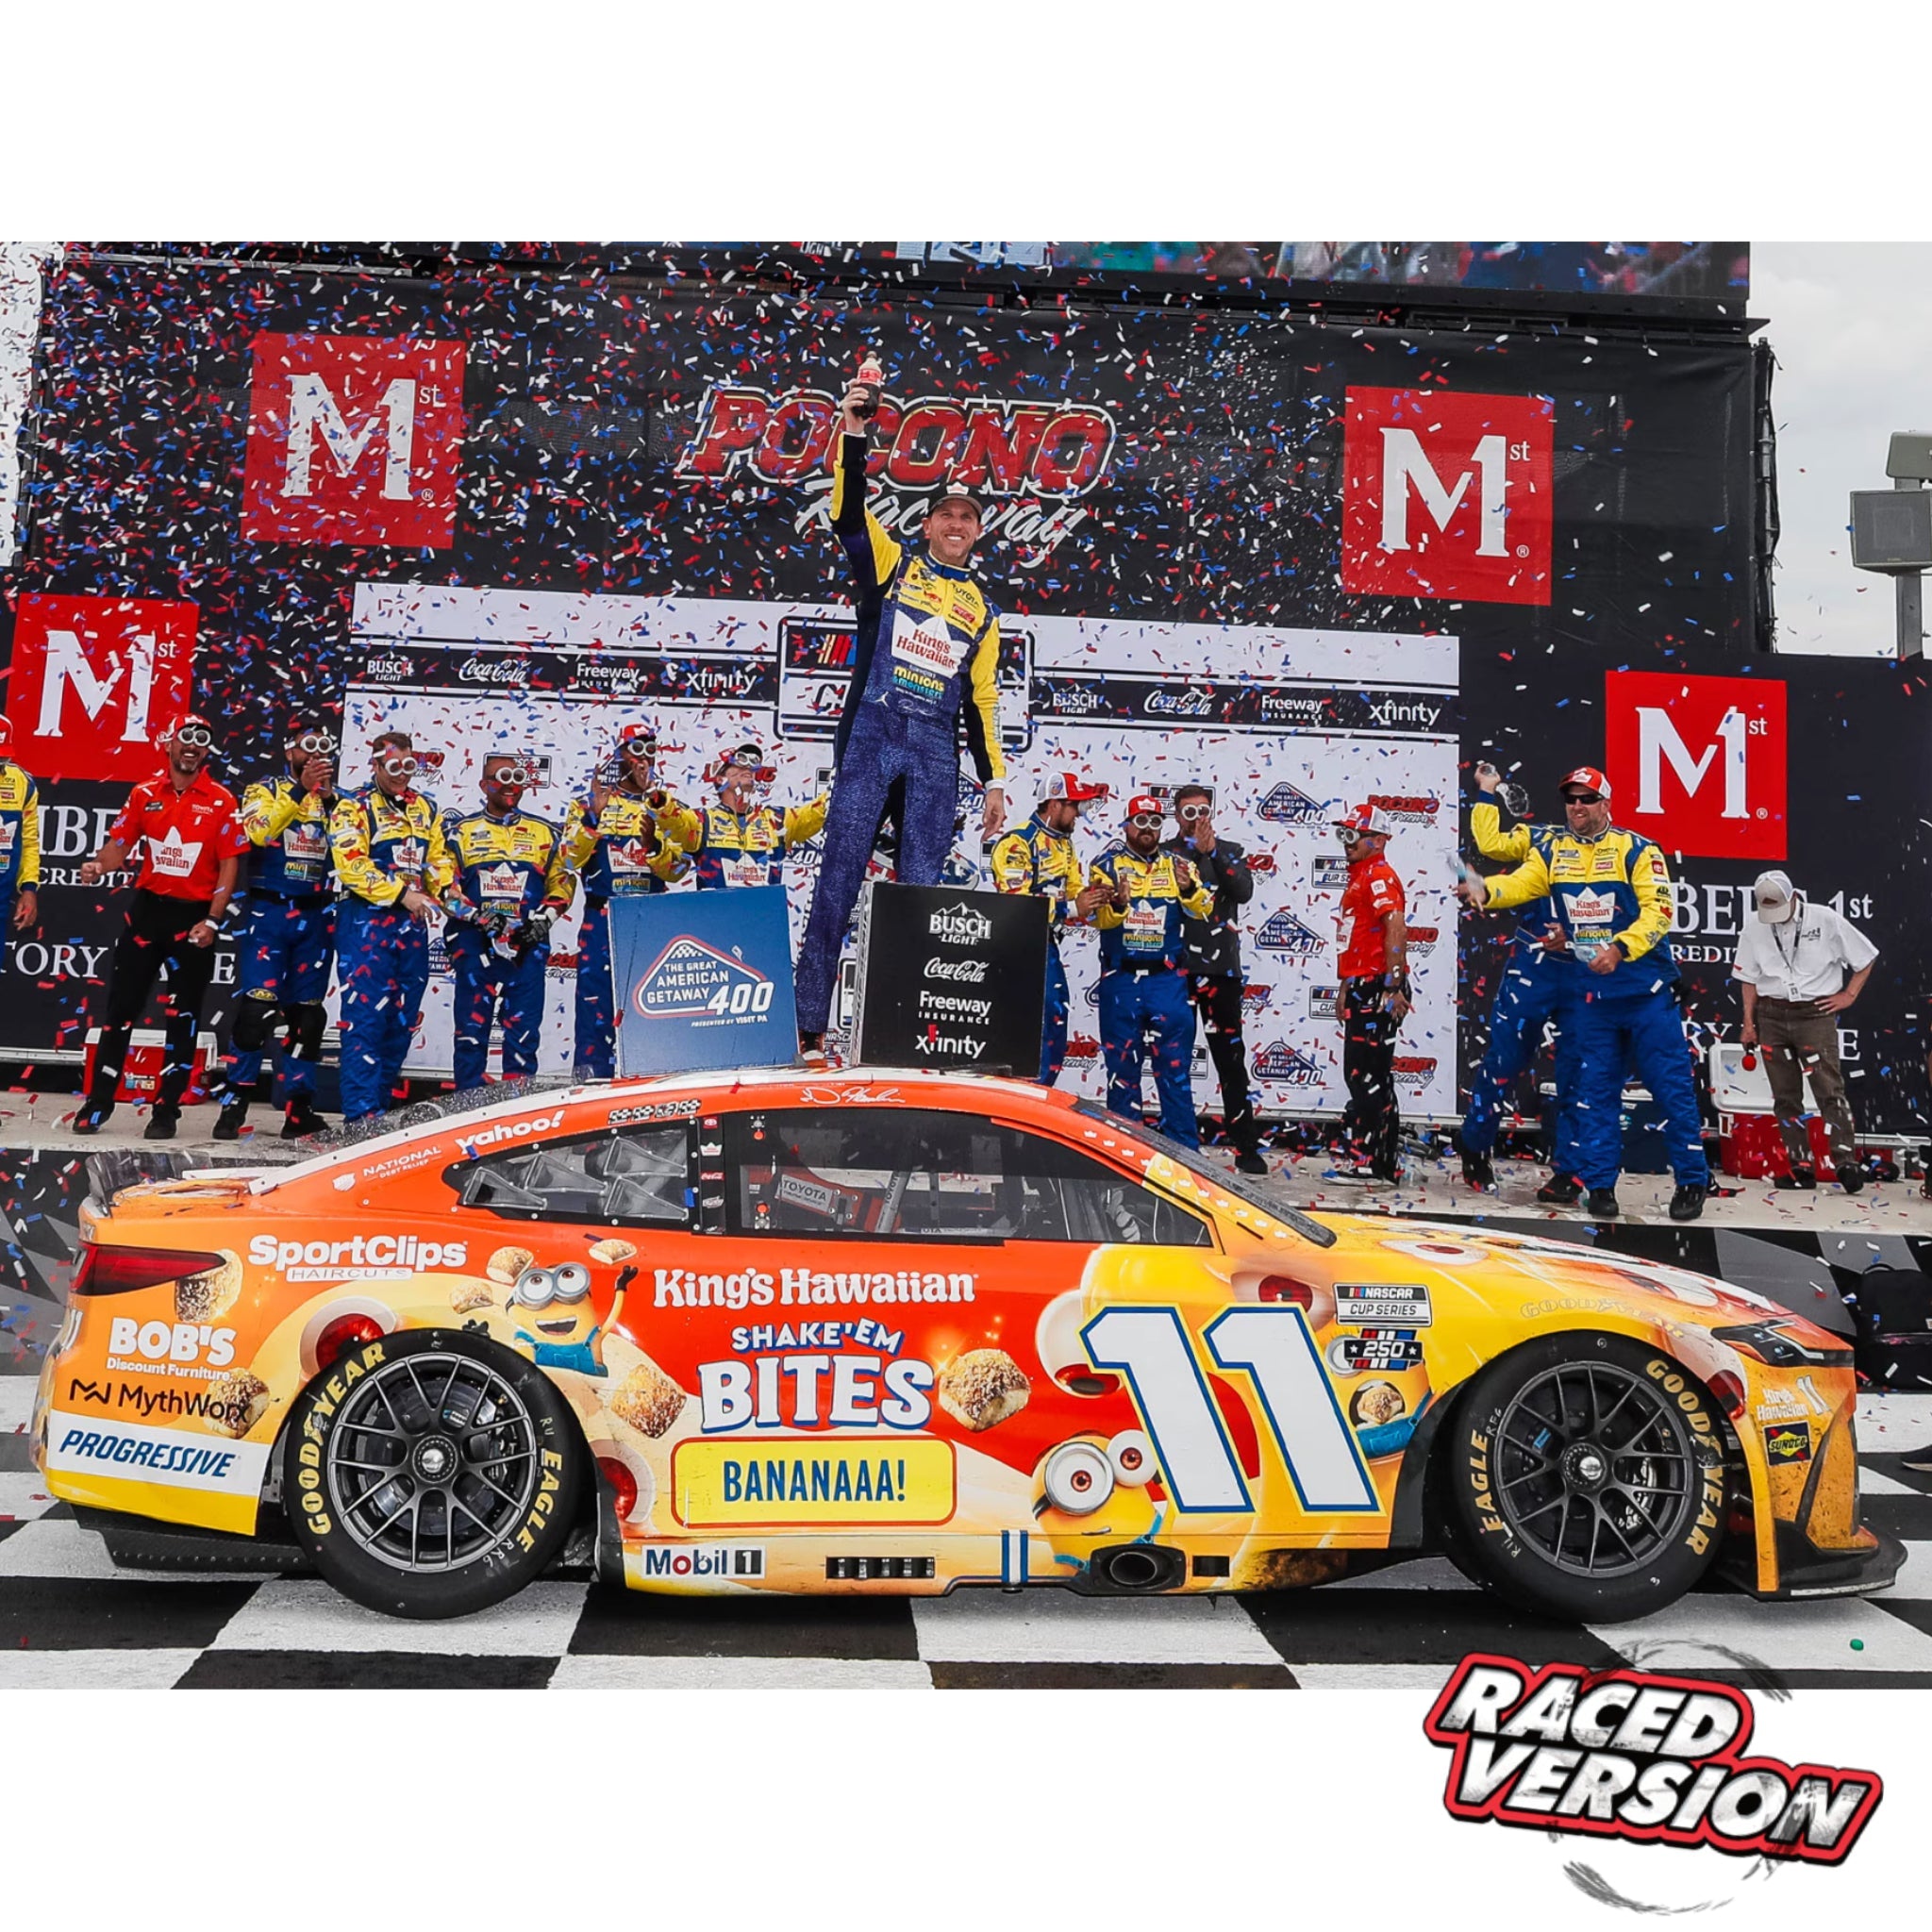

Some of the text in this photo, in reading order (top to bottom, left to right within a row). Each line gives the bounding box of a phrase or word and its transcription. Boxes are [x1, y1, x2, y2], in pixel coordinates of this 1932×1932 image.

[675, 386, 1115, 496] POCONO
[896, 635, 957, 669] Hawaiian
[912, 628, 951, 655] King's
[367, 659, 413, 675] BUSCH
[375, 673, 403, 682] LIGHT
[576, 662, 640, 682] Freeway
[893, 665, 944, 692] minions
[686, 667, 757, 695] xfinity
[1262, 695, 1323, 714] Freeway
[1370, 699, 1441, 727] xfinity
[929, 913, 991, 940] BUSCH
[941, 933, 977, 945] LIGHT
[657, 970, 729, 988] AMERICAN
[664, 959, 717, 973] THE GREAT
[924, 957, 990, 983] Coca-Cola
[647, 981, 774, 1016] GETAWAY 400
[920, 990, 991, 1017] Freeway
[736, 1016, 756, 1024] VISIT
[757, 1014, 768, 1023] PA
[918, 1010, 990, 1025] INSURANCE
[363, 1145, 442, 1177] NATIONAL
[379, 1160, 429, 1179] DEBT RELIEF
[782, 1179, 827, 1201] TOYOTA
[248, 1235, 468, 1273] SportClips
[291, 1268, 408, 1281] HAIRCUTS
[654, 1267, 975, 1310] King's Hawaiian
[1365, 1287, 1414, 1300] NASCAR
[1350, 1303, 1417, 1316] CUP SERIES
[108, 1317, 237, 1367] BOB'S
[1363, 1341, 1406, 1357] 250
[107, 1358, 232, 1382] Discount Furniture
[118, 1383, 249, 1424] MythWorx
[697, 1353, 935, 1433] BITES
[1078, 1302, 1387, 1517] 11
[59, 1428, 237, 1478] PROGRESSIVE
[1768, 1436, 1809, 1454] SUNOCO
[723, 1458, 907, 1503] BANANAAA!
[1469, 1428, 1505, 1532] EAGLE
[515, 1448, 562, 1554] EAGLE
[644, 1549, 727, 1576] Mobil
